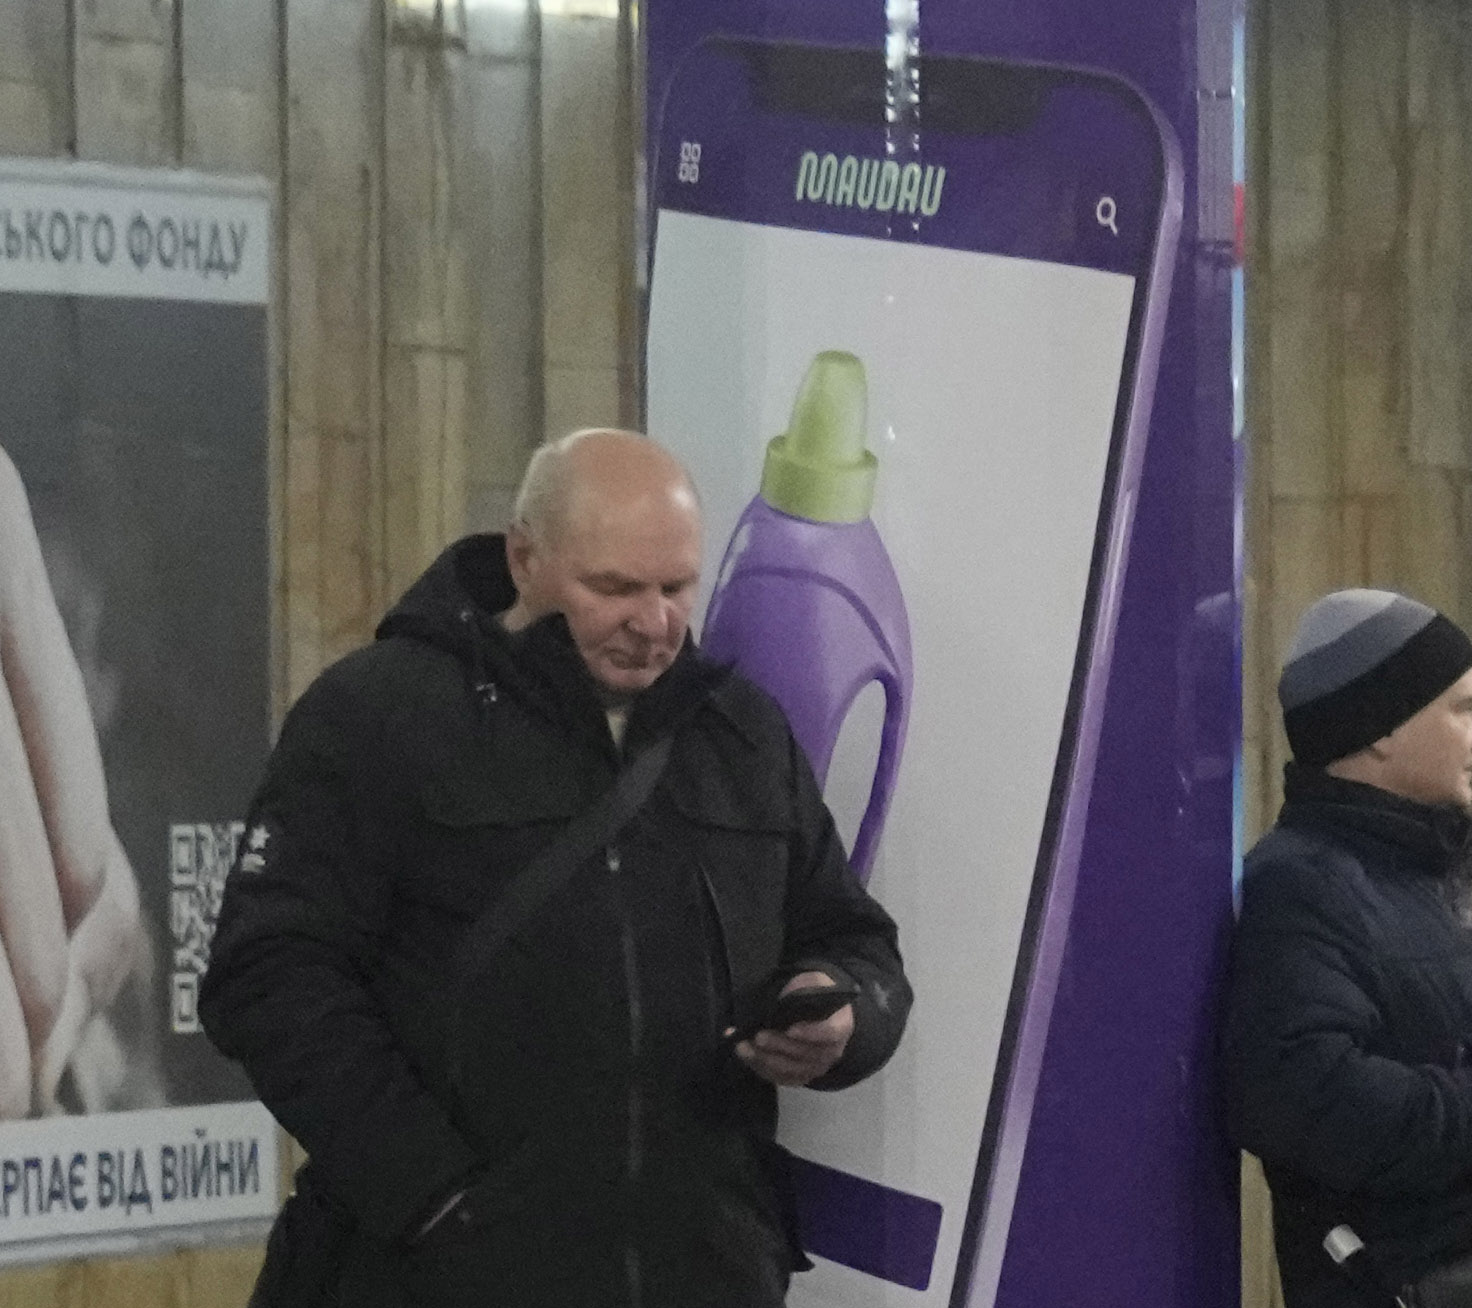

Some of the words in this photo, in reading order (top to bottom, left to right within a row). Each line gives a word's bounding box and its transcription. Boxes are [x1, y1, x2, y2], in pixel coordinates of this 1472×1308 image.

[796, 151, 946, 215] MAUDAU
[0, 208, 115, 266] ЬКОГО
[126, 209, 248, 280] ФОНДУ
[0, 1153, 88, 1217] РПАЄ
[97, 1148, 153, 1216] ВІД
[160, 1127, 260, 1201] ВІЙНИ
